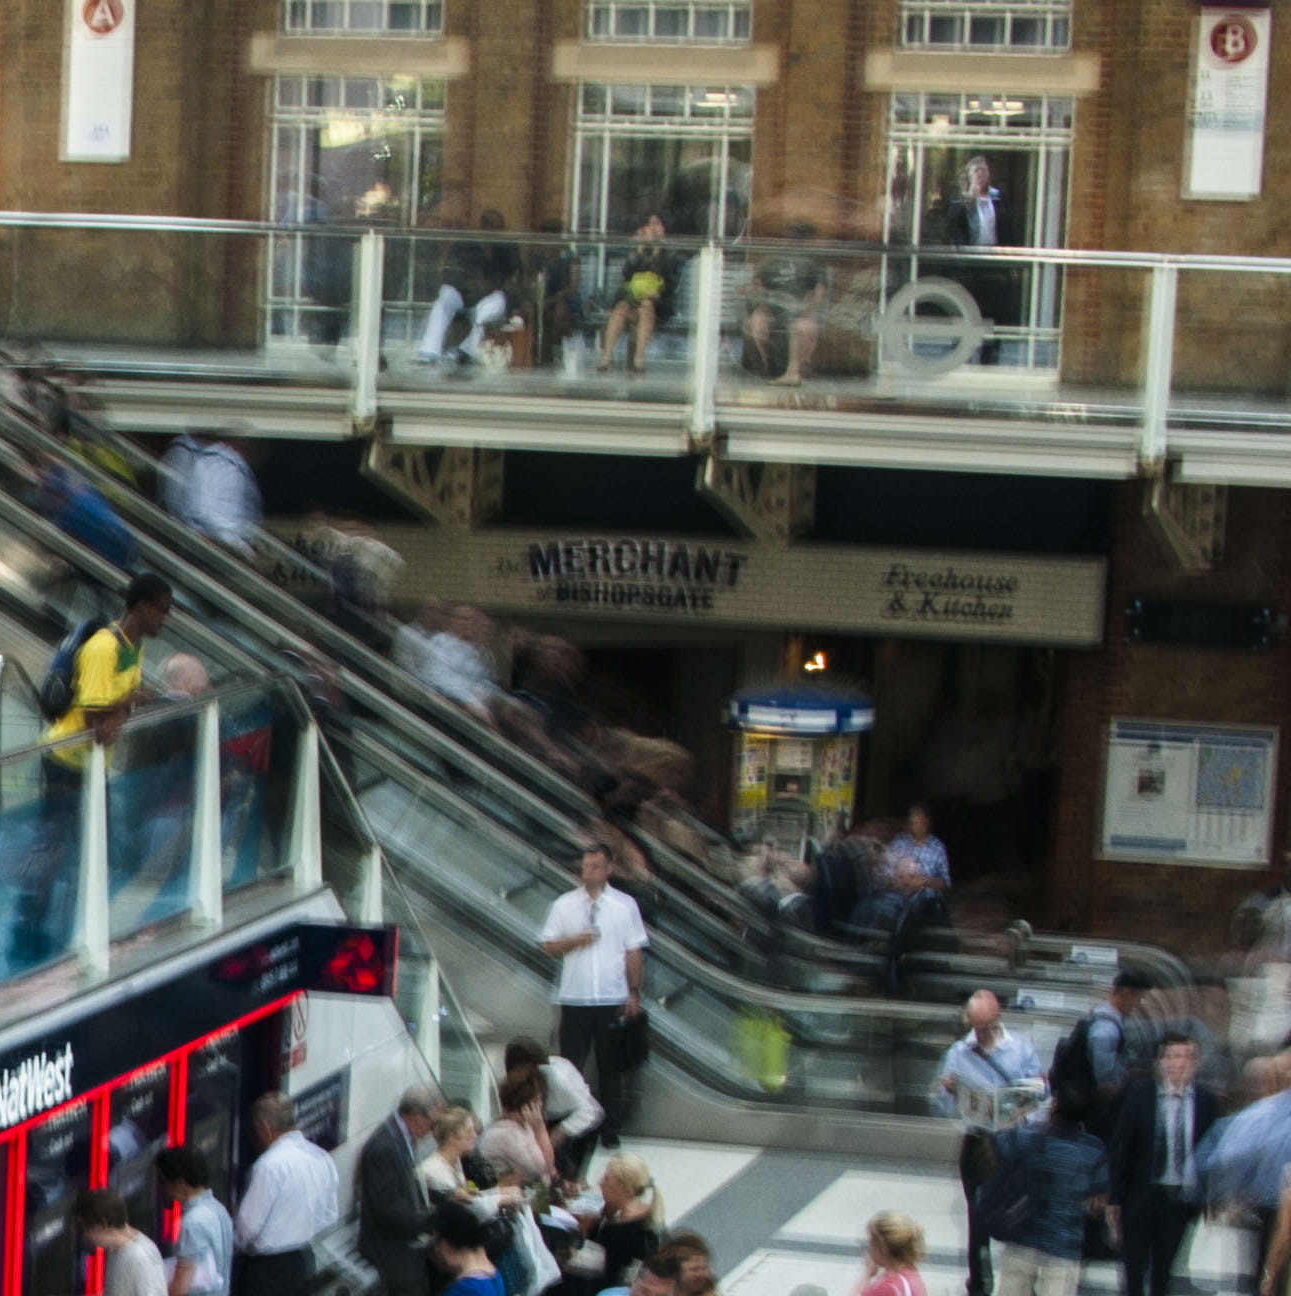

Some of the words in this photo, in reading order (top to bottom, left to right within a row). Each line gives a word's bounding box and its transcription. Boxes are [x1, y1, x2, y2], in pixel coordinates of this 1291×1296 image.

[1224, 24, 1247, 55] B
[527, 539, 749, 588] MERCHANT
[883, 562, 1021, 594] Freehouse
[555, 579, 716, 611] BISHOPSGATE
[889, 588, 909, 612] &
[916, 590, 1015, 619] Kitchen
